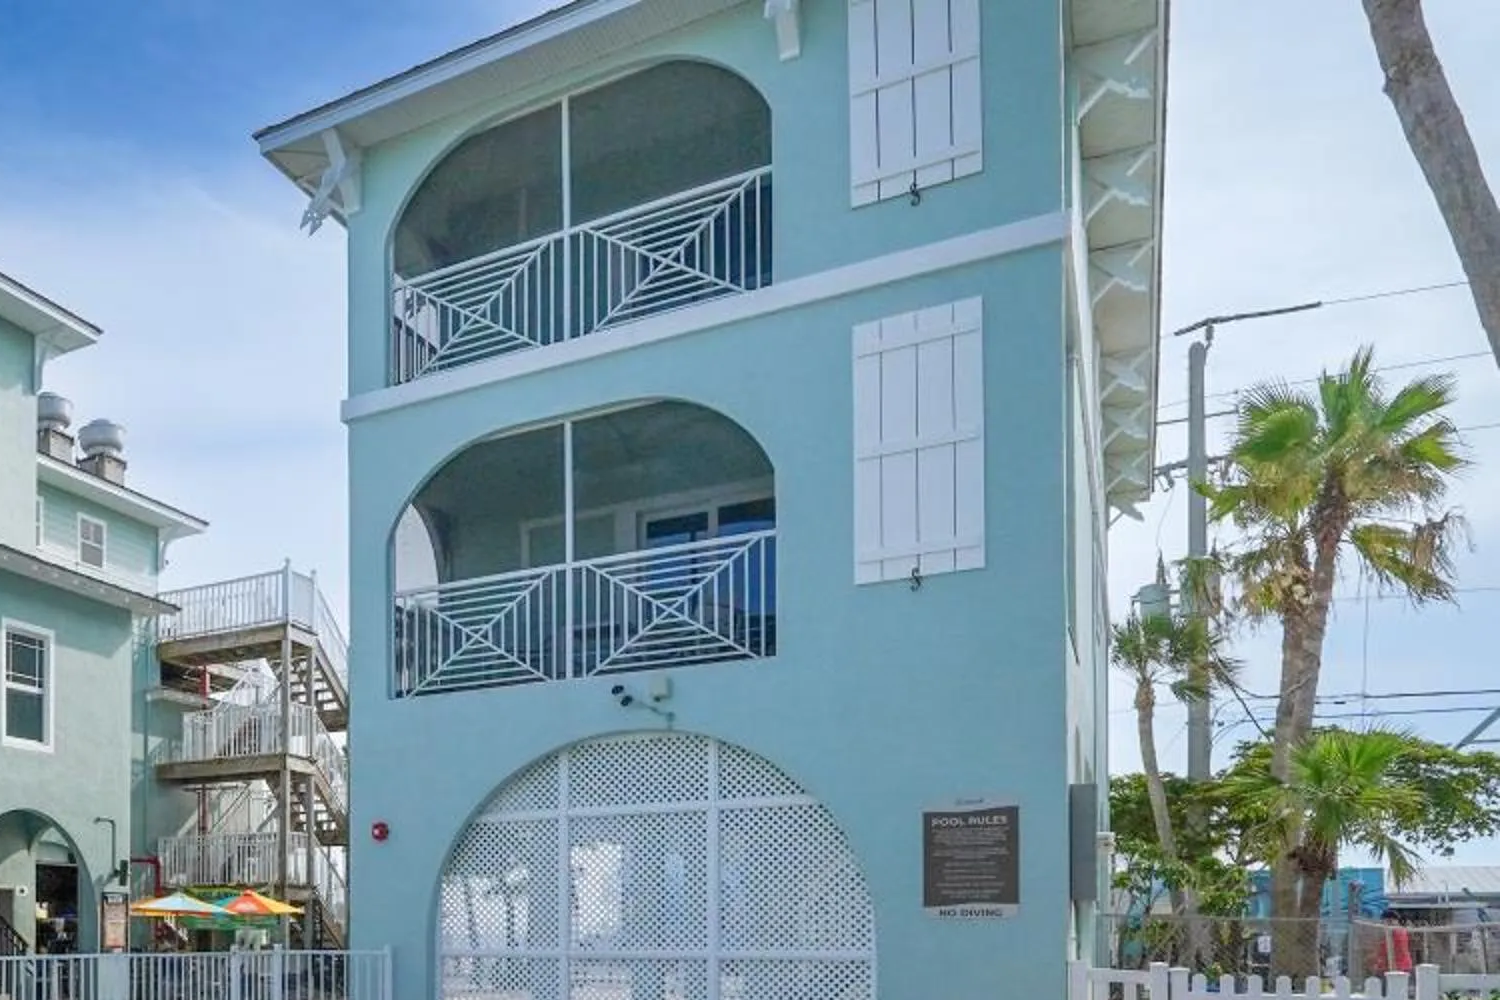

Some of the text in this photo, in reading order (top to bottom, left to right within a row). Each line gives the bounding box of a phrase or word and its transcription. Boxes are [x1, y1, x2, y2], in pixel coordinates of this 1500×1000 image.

[932, 815, 1008, 827] POOL RULES
[940, 907, 1003, 917] NO DIVING
